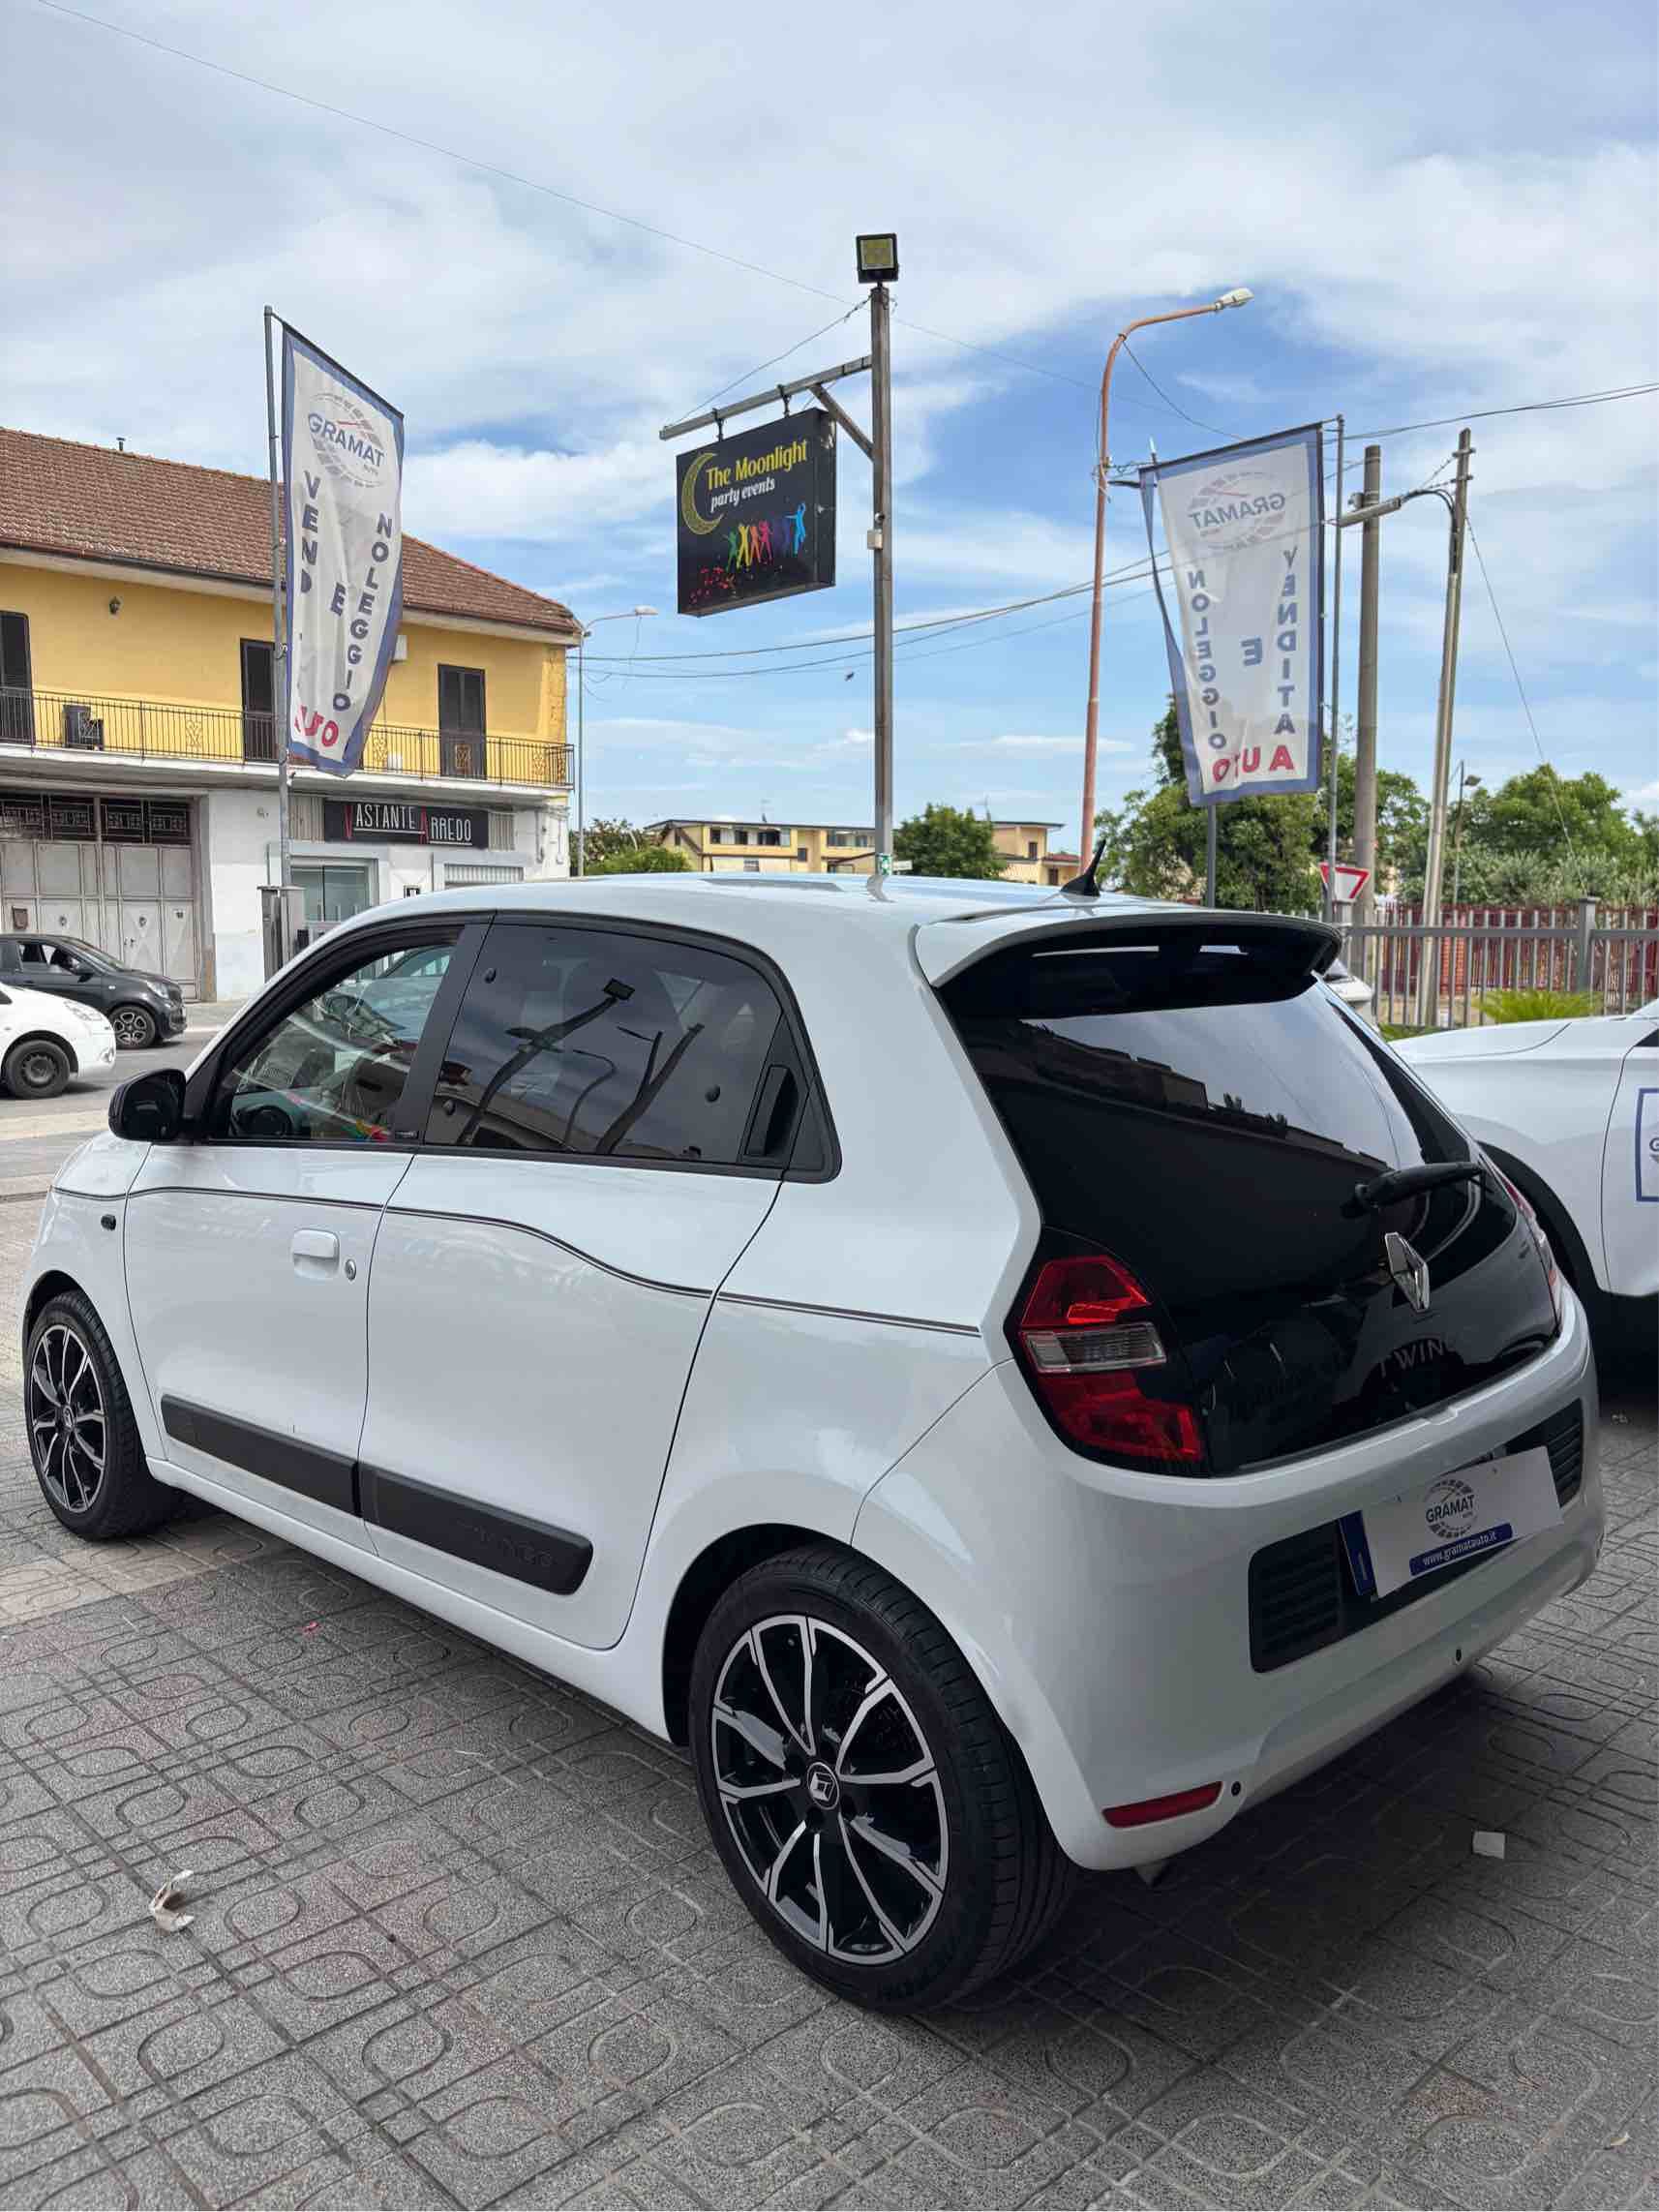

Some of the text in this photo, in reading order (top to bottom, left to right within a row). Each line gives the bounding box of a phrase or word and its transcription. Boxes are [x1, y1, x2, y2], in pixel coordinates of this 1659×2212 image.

[308, 412, 385, 469] GRAMAT
[706, 439, 807, 490] The Moonlight
[710, 476, 775, 513] party events
[330, 582, 347, 618] E
[333, 512, 393, 712] NOLEGGIO
[345, 803, 472, 844] VASTANTE ARREDO
[1425, 1494, 1475, 1524] GRAMAT
